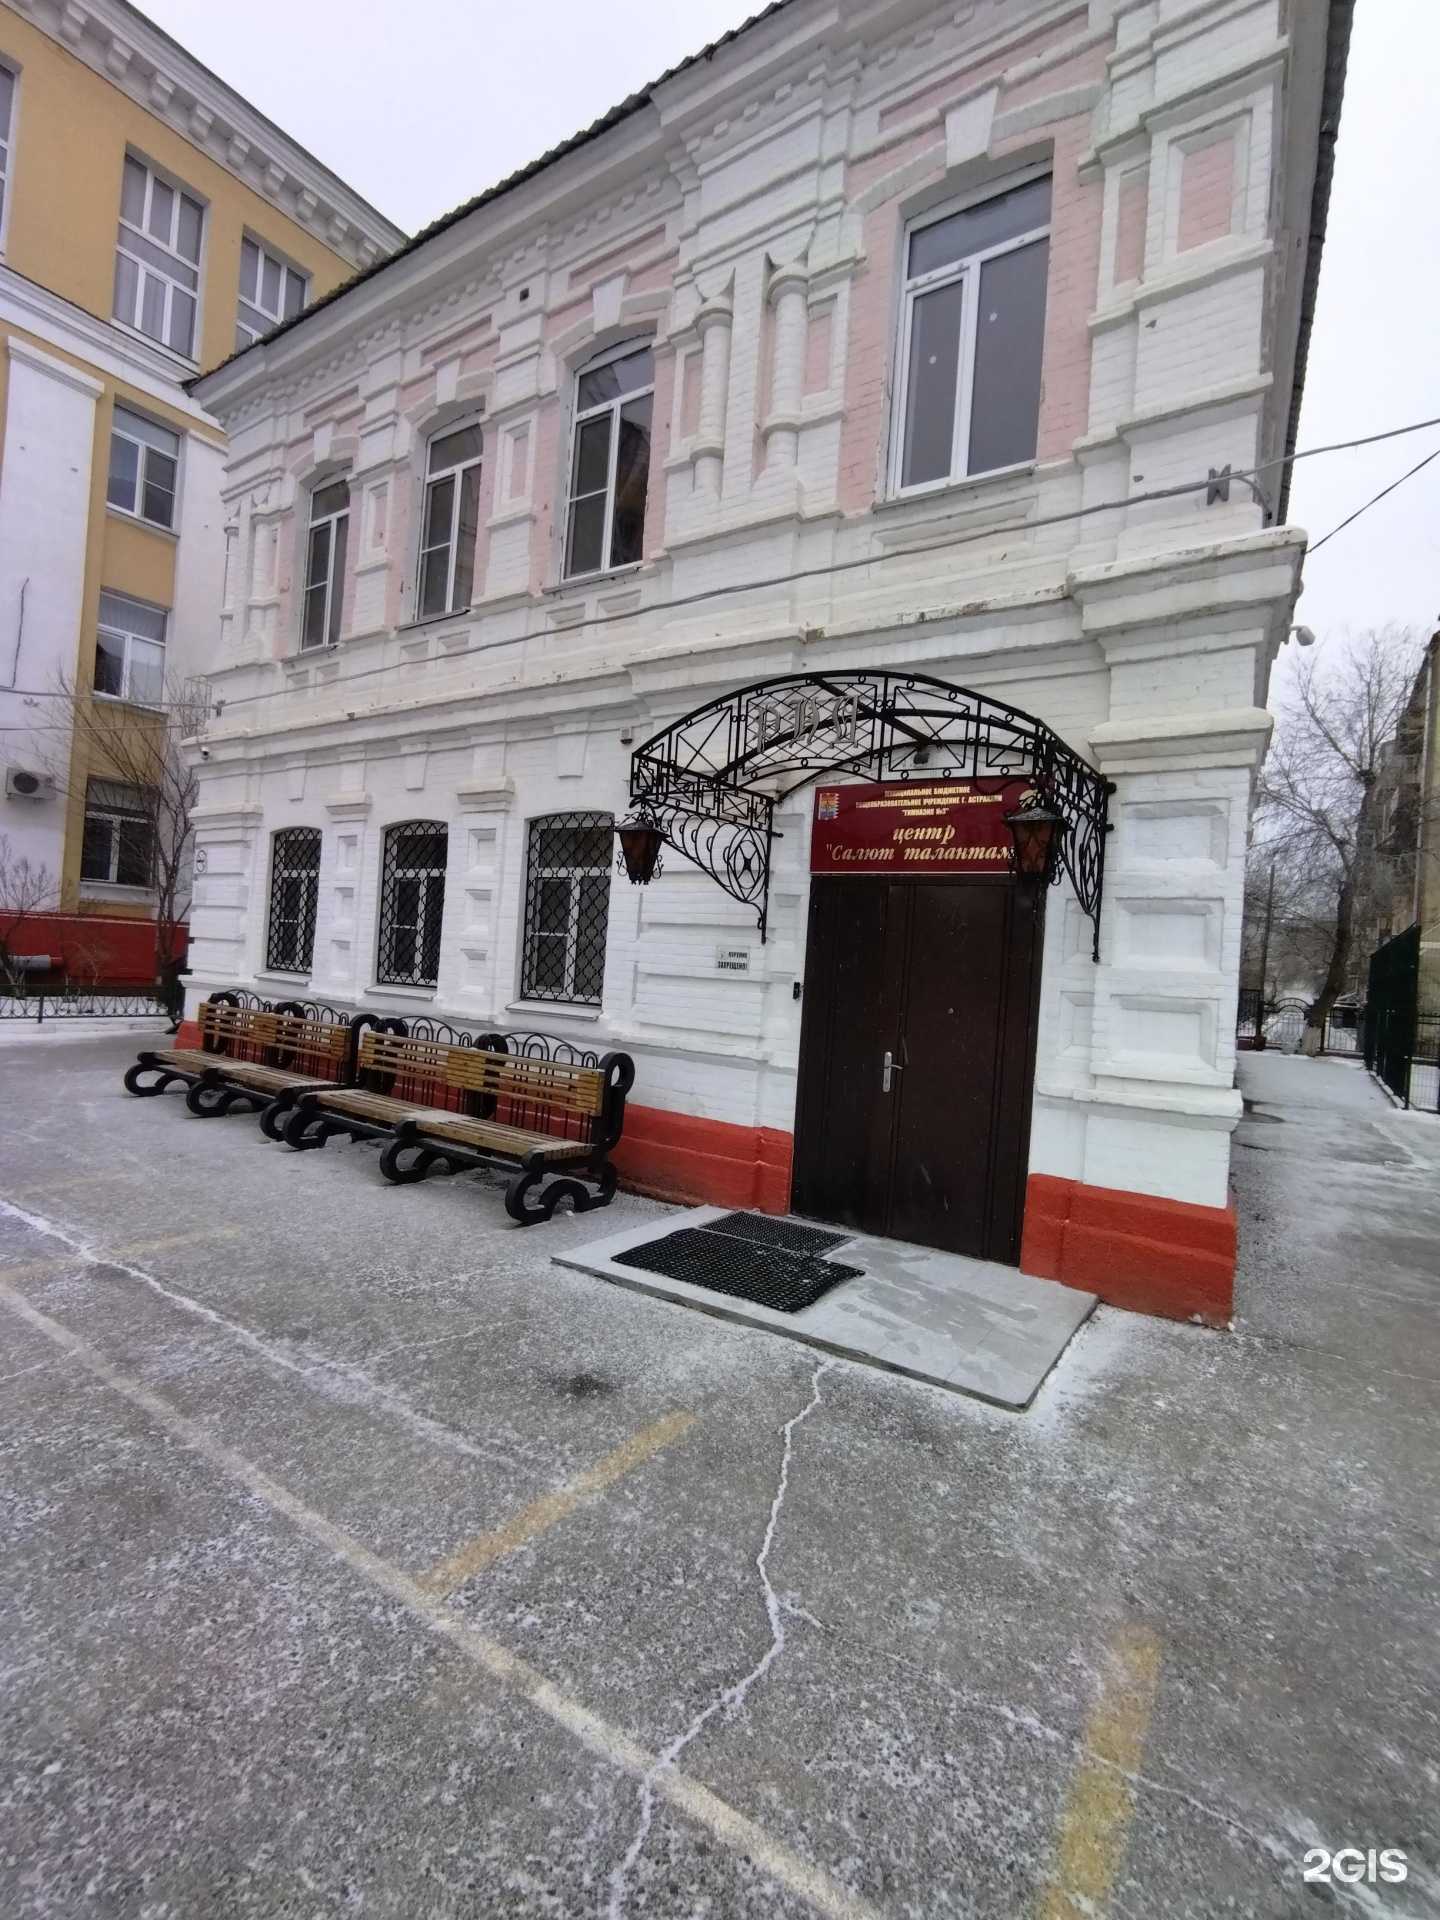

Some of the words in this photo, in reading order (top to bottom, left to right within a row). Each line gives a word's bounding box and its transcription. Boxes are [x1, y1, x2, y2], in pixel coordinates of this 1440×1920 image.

[885, 787, 932, 798] ЦИПАЛЬНОЕ
[856, 798, 921, 809] ЩЕОБРАЗОВАТЕЛЬНОЕ
[968, 794, 1003, 804] АСТРА
[893, 824, 956, 846] центр
[826, 843, 895, 862] "Салют
